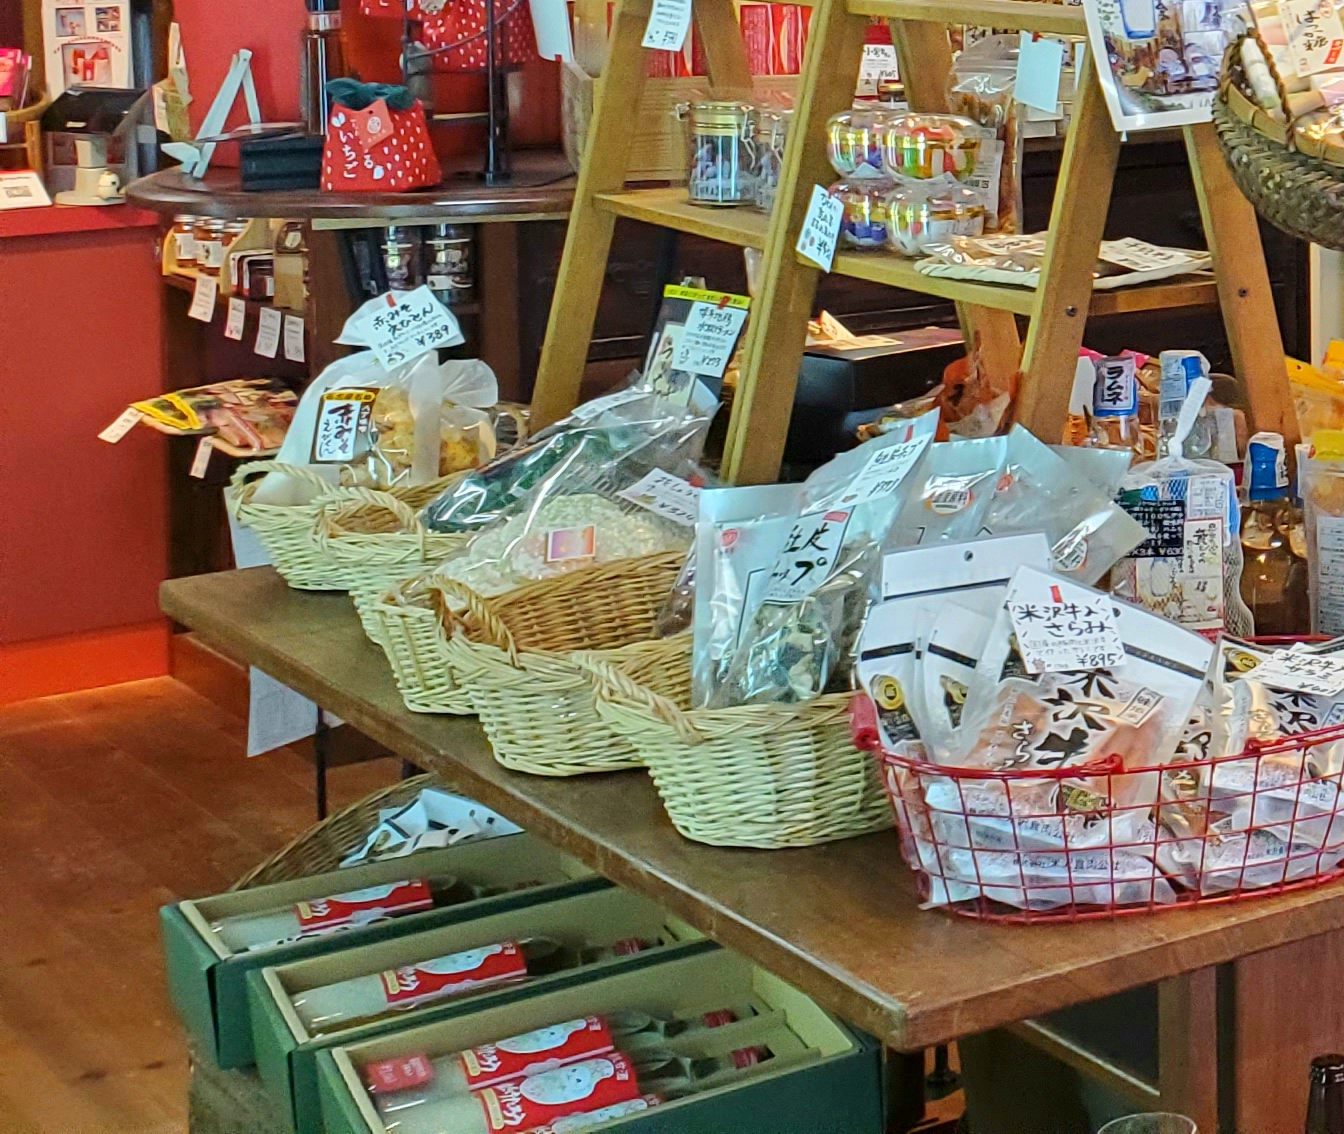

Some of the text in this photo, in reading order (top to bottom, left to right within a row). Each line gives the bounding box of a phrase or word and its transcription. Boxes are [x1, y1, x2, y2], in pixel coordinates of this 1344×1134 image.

[1106, 365, 1126, 406] ラムネ
[1076, 653, 1118, 667] ¥895
